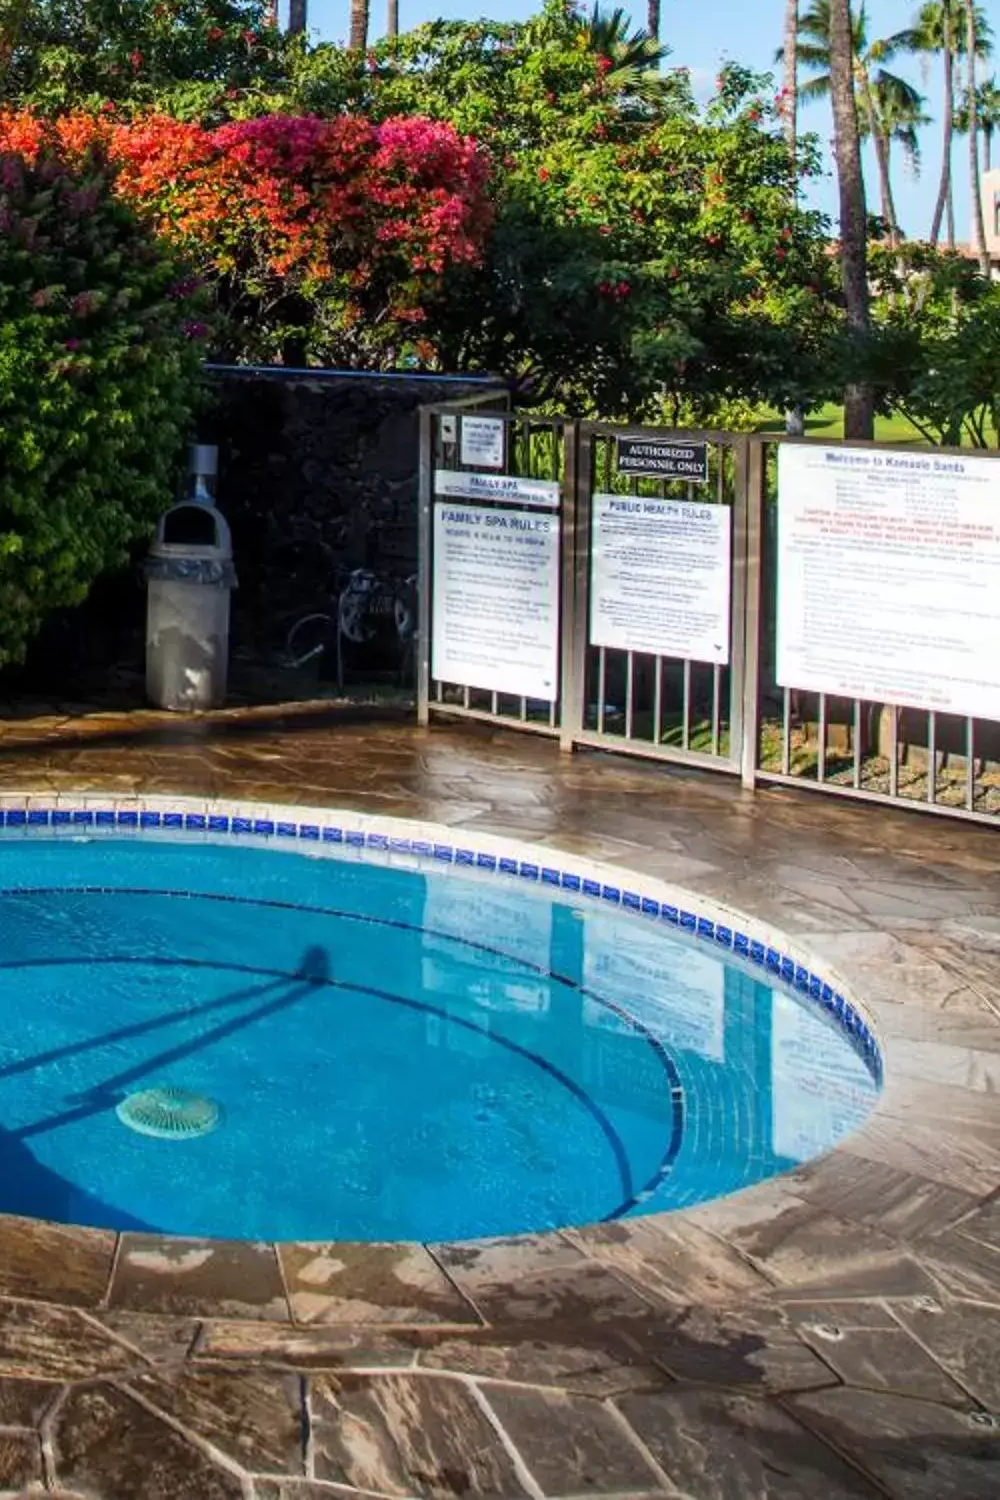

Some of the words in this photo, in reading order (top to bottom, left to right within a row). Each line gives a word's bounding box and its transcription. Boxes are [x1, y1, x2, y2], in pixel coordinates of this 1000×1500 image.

[630, 445, 695, 458] AUTHORIZED
[825, 453, 871, 465] Welcome
[873, 456, 883, 467] to
[619, 455, 676, 470] PERSONNEL
[677, 461, 705, 473] ONLY
[609, 501, 640, 513] PUBLIC
[643, 503, 679, 515] HEALTH
[681, 507, 712, 520] RULES
[441, 510, 482, 525] FAMILY
[485, 515, 508, 528] SPA
[510, 517, 551, 532] RULES
